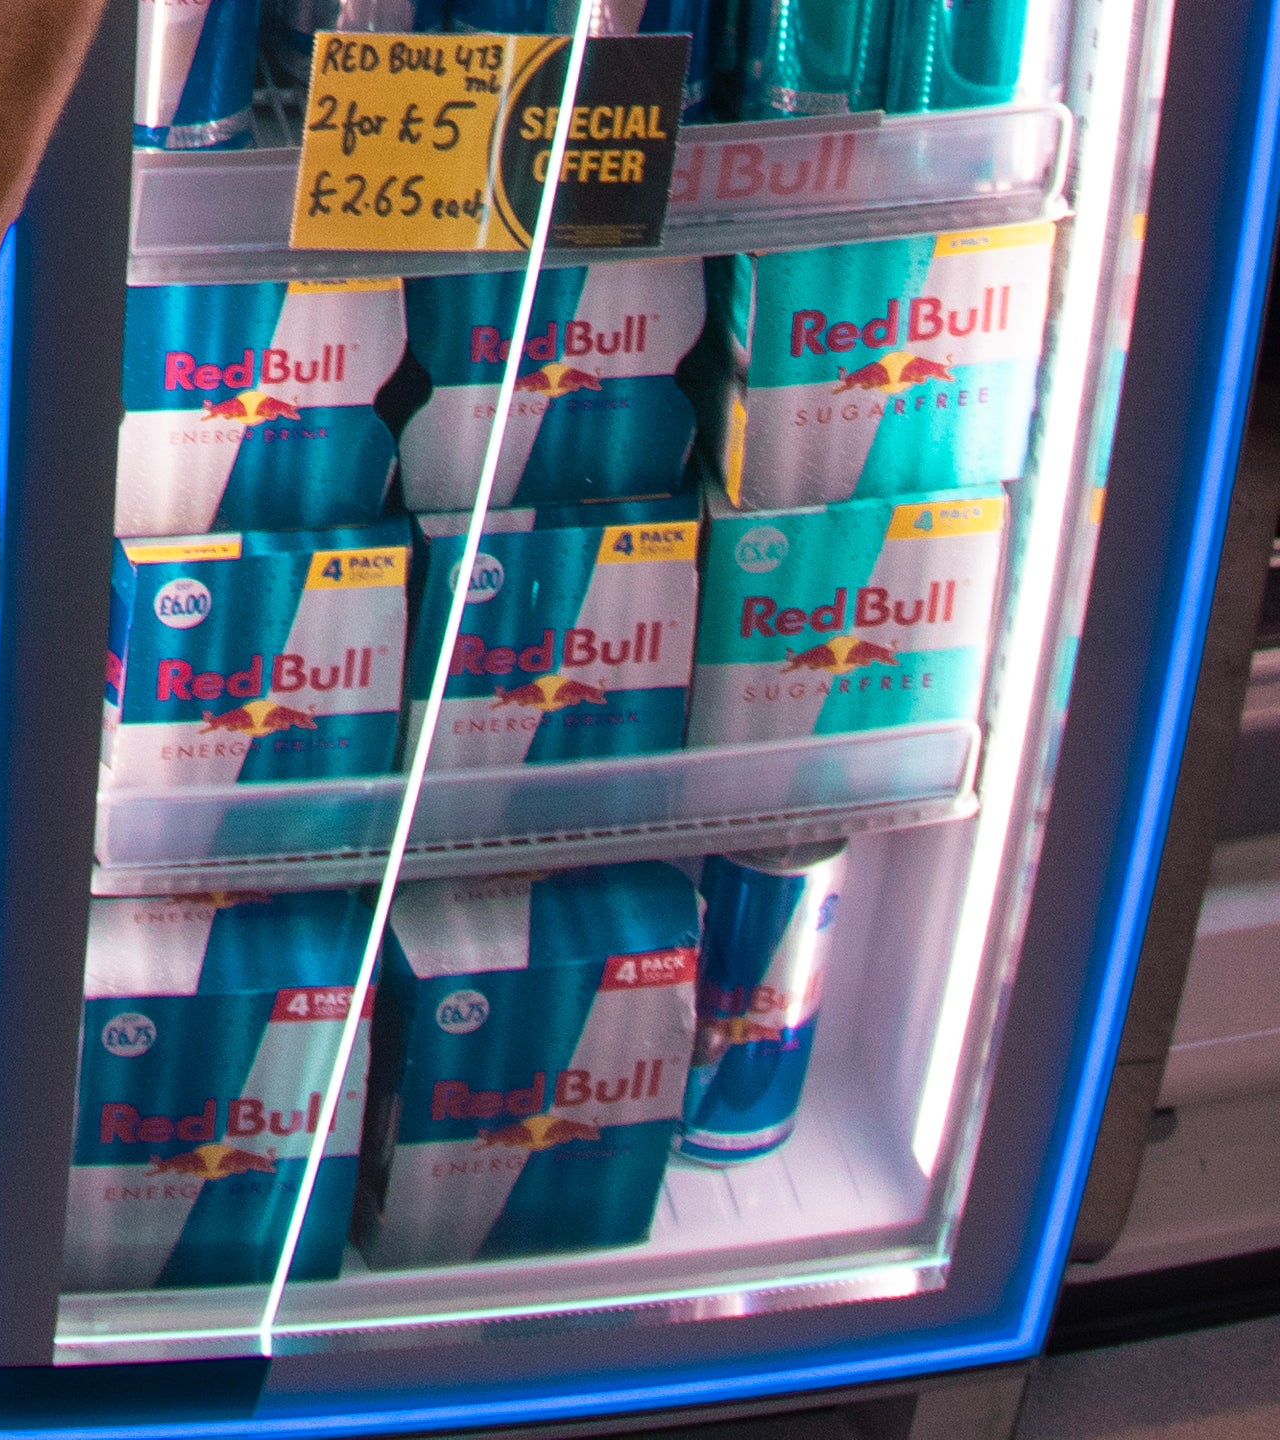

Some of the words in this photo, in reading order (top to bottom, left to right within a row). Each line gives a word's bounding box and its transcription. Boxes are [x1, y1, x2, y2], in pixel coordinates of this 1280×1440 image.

[321, 39, 380, 75] RED
[389, 41, 447, 77] BULL
[454, 43, 503, 72] 473
[309, 94, 338, 133] 2
[341, 100, 388, 156] for
[520, 105, 667, 140] SPECIAL
[533, 150, 646, 183] OFFER
[715, 133, 856, 202] Bull
[308, 169, 425, 217] £2.65
[431, 189, 484, 223] each
[563, 313, 648, 358] Bull
[790, 298, 900, 358] Red
[906, 285, 1012, 342] Bull
[163, 349, 255, 392] Red
[261, 344, 347, 386] Bull
[168, 427, 256, 448] ENERGY
[263, 427, 329, 444] DRINK
[913, 509, 934, 531] 4
[612, 531, 635, 556] 4
[639, 529, 685, 545] PACK
[322, 557, 344, 582] 4
[348, 554, 395, 570] PACK
[159, 591, 210, 617] £6.00
[739, 586, 848, 640] Red
[853, 581, 956, 629] Bull
[450, 629, 555, 676] Red
[563, 621, 663, 668] Bull
[155, 655, 263, 703] Red
[270, 646, 373, 694] Bull
[742, 673, 936, 703] SUGARFREE
[160, 740, 262, 762] ENERGY
[616, 960, 638, 983] 4
[640, 954, 686, 974] PACK
[285, 992, 309, 1016] 4
[430, 1071, 546, 1121] Red
[553, 1058, 664, 1109] Bull
[99, 1099, 218, 1144] Red
